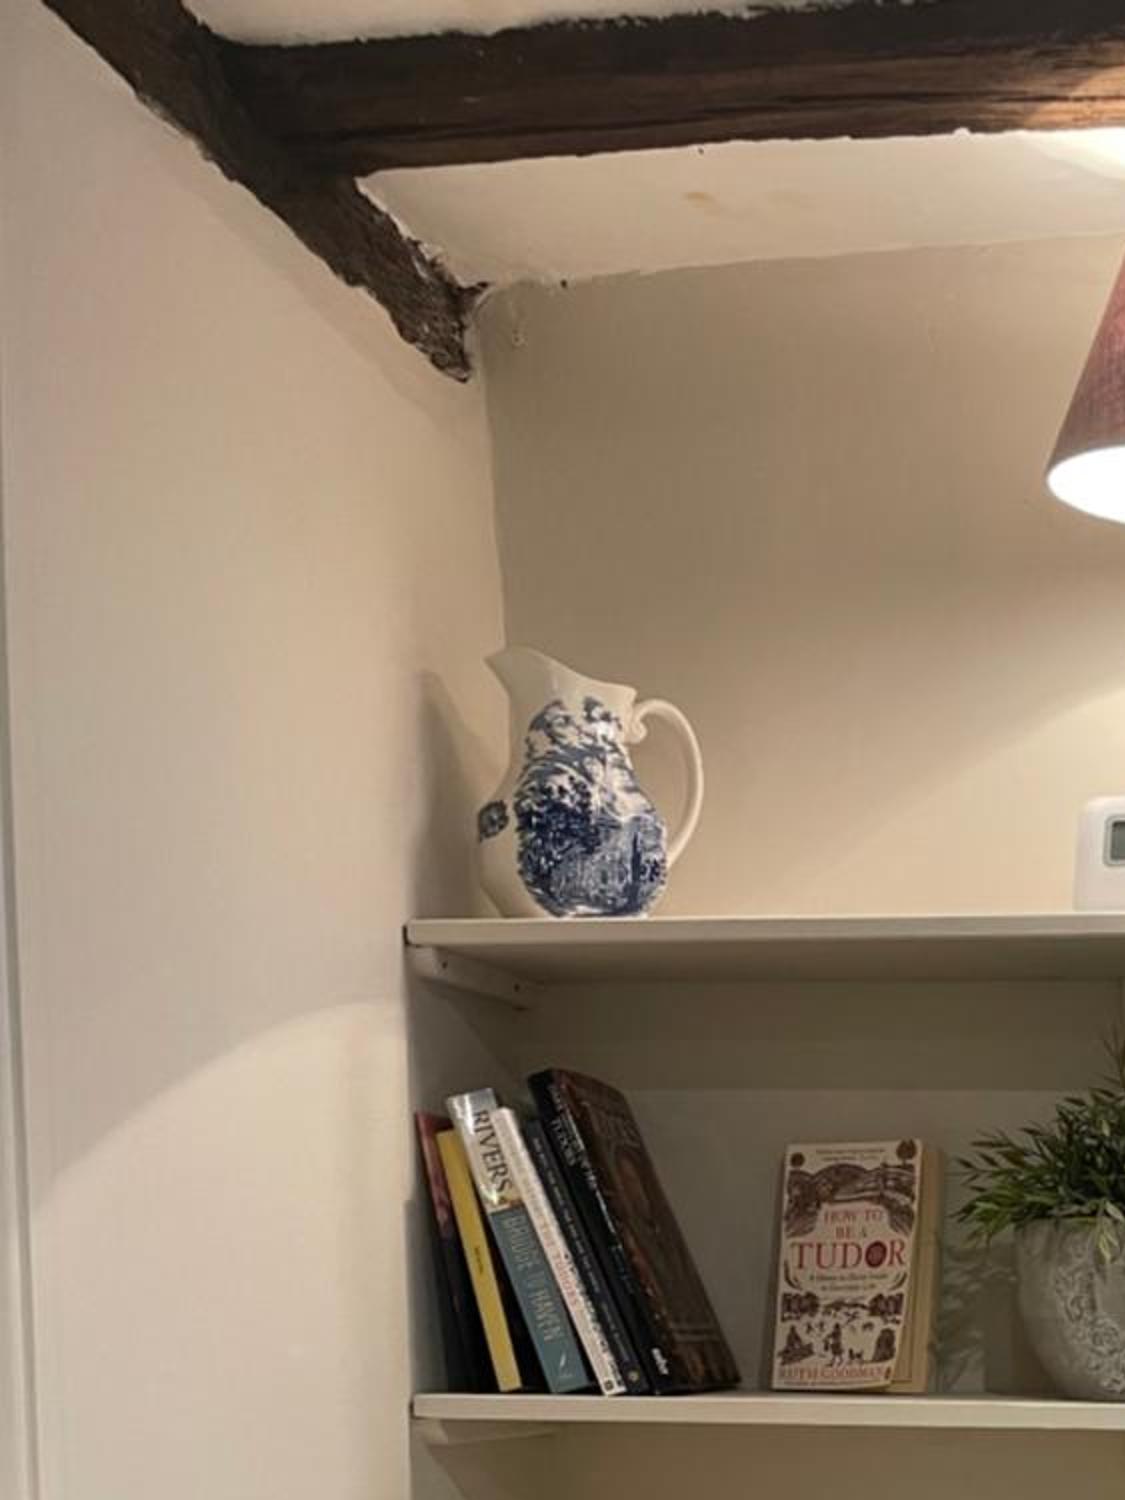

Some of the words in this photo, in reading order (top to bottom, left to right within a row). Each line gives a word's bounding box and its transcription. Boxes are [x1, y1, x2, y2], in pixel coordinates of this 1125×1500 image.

[473, 1109, 511, 1193] RIVERS
[824, 1210, 857, 1225] HOW
[865, 1208, 882, 1222] TO
[835, 1226, 852, 1240] BE
[790, 1238, 907, 1270] TUDOR
[532, 1289, 562, 1341] HAVEN
